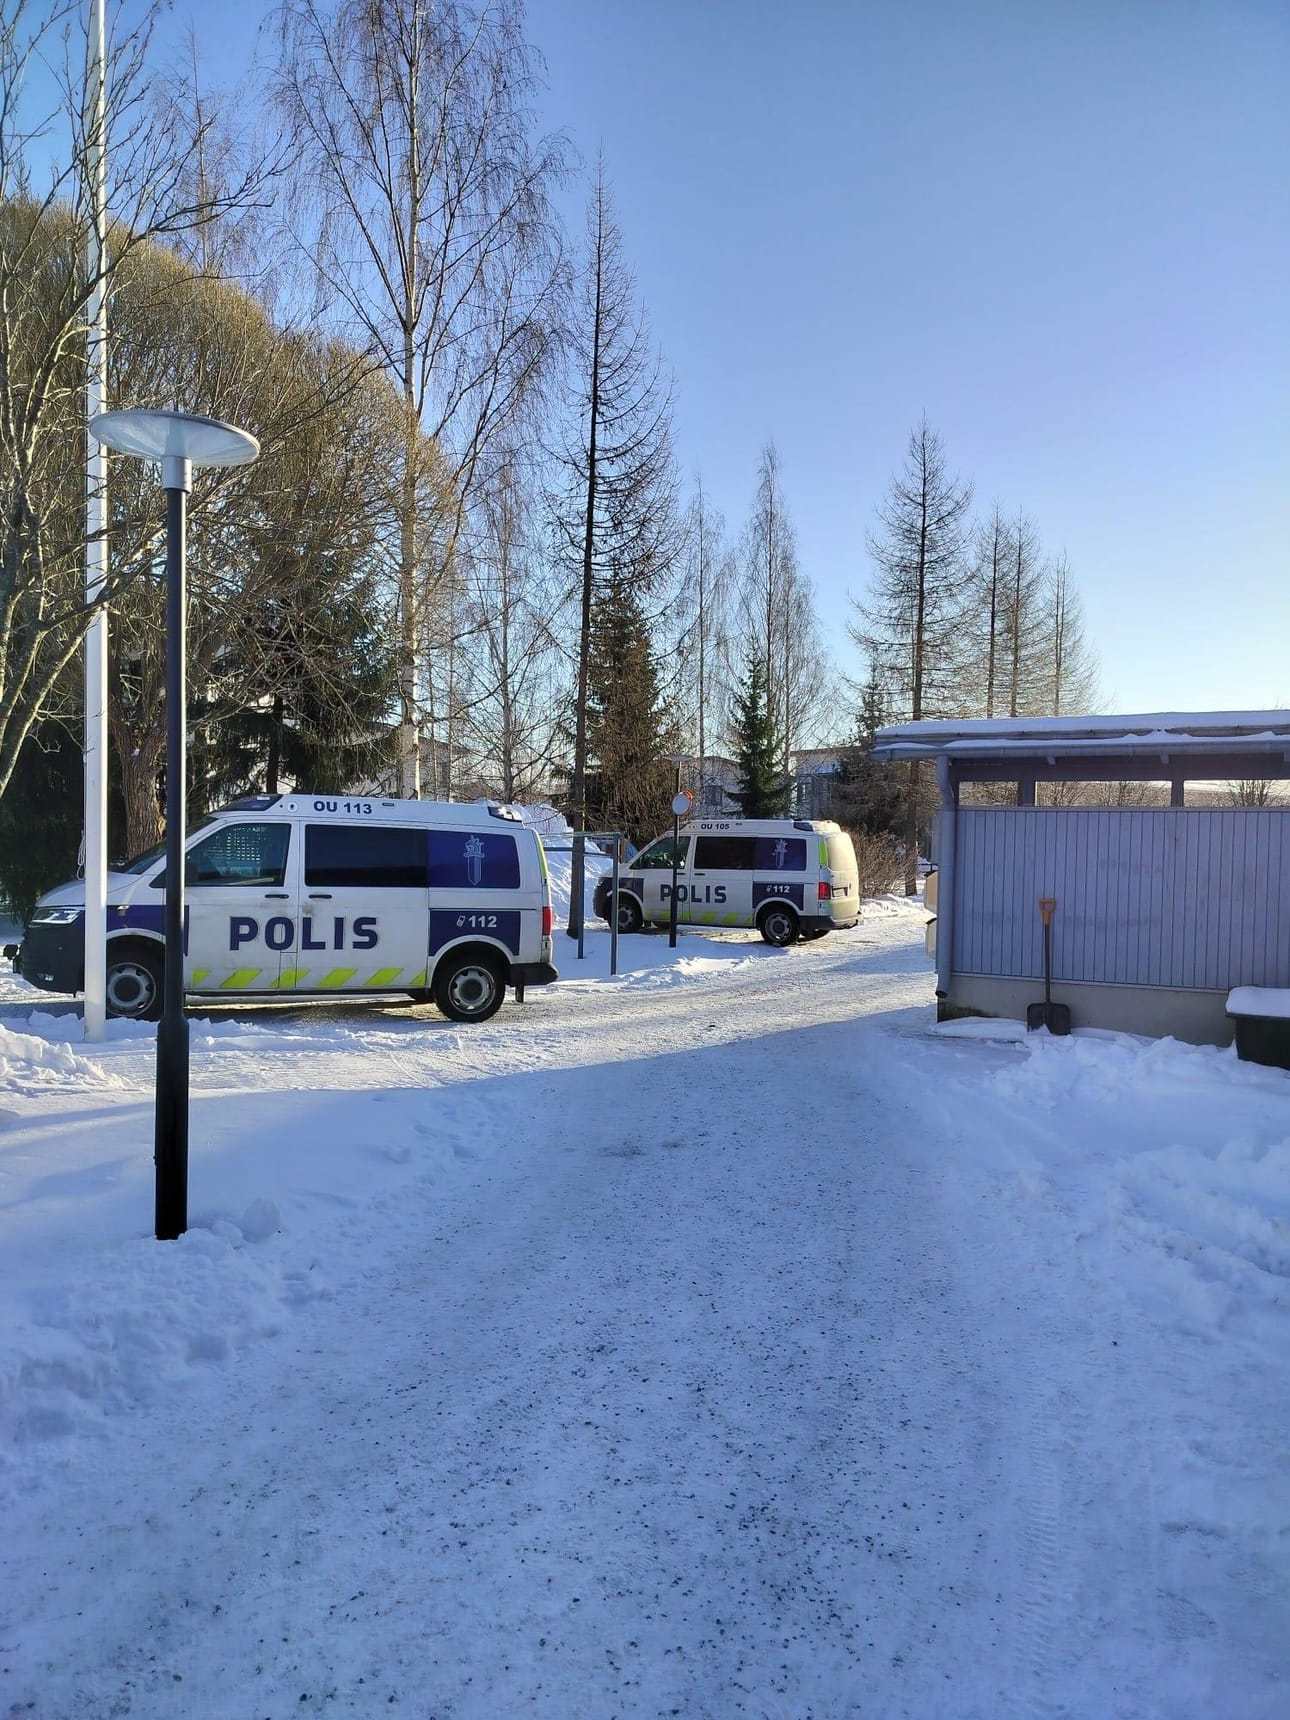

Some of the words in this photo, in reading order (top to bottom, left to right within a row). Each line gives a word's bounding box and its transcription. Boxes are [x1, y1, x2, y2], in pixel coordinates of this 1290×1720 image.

[314, 800, 338, 813] OU
[343, 802, 373, 815] 113
[660, 884, 727, 904] POLIS
[772, 885, 791, 894] 112
[468, 915, 498, 928] 112
[229, 916, 378, 951] POLIS
